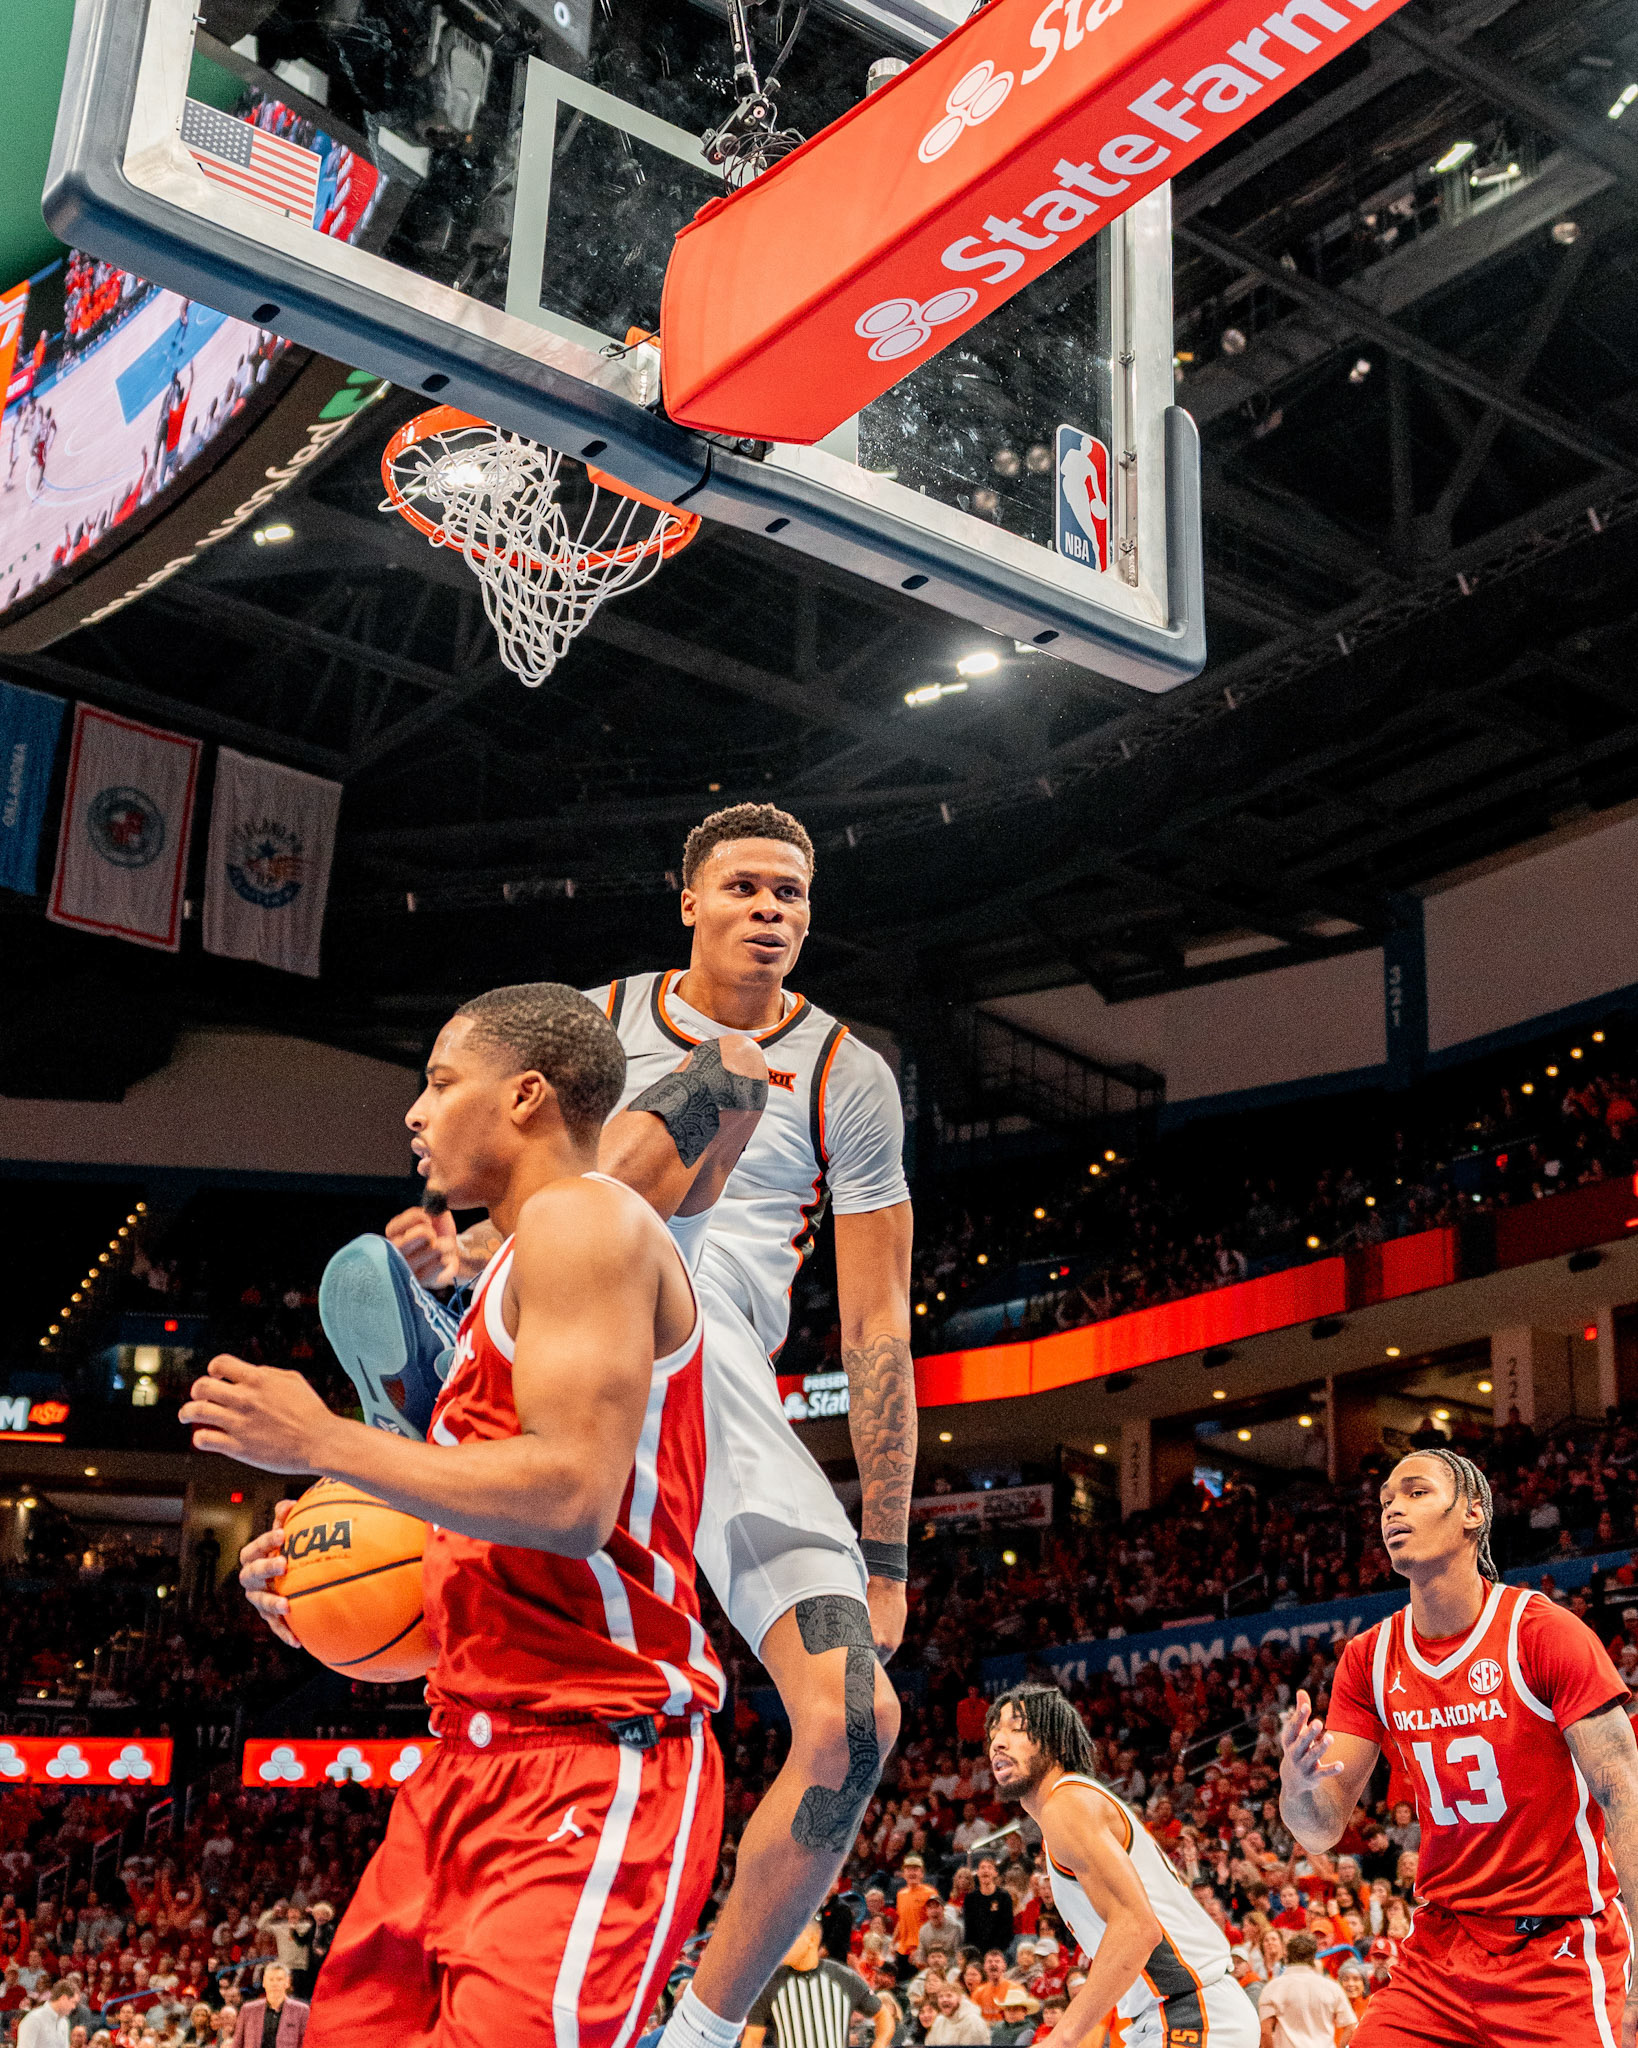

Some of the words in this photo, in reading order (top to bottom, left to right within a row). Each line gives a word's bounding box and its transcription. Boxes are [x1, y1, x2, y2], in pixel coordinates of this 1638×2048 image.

[1065, 531, 1090, 563] NBA
[1471, 1661, 1500, 1690] SEC
[1392, 1698, 1507, 1731] OKLAHOMA
[1412, 1735, 1508, 1826] 13
